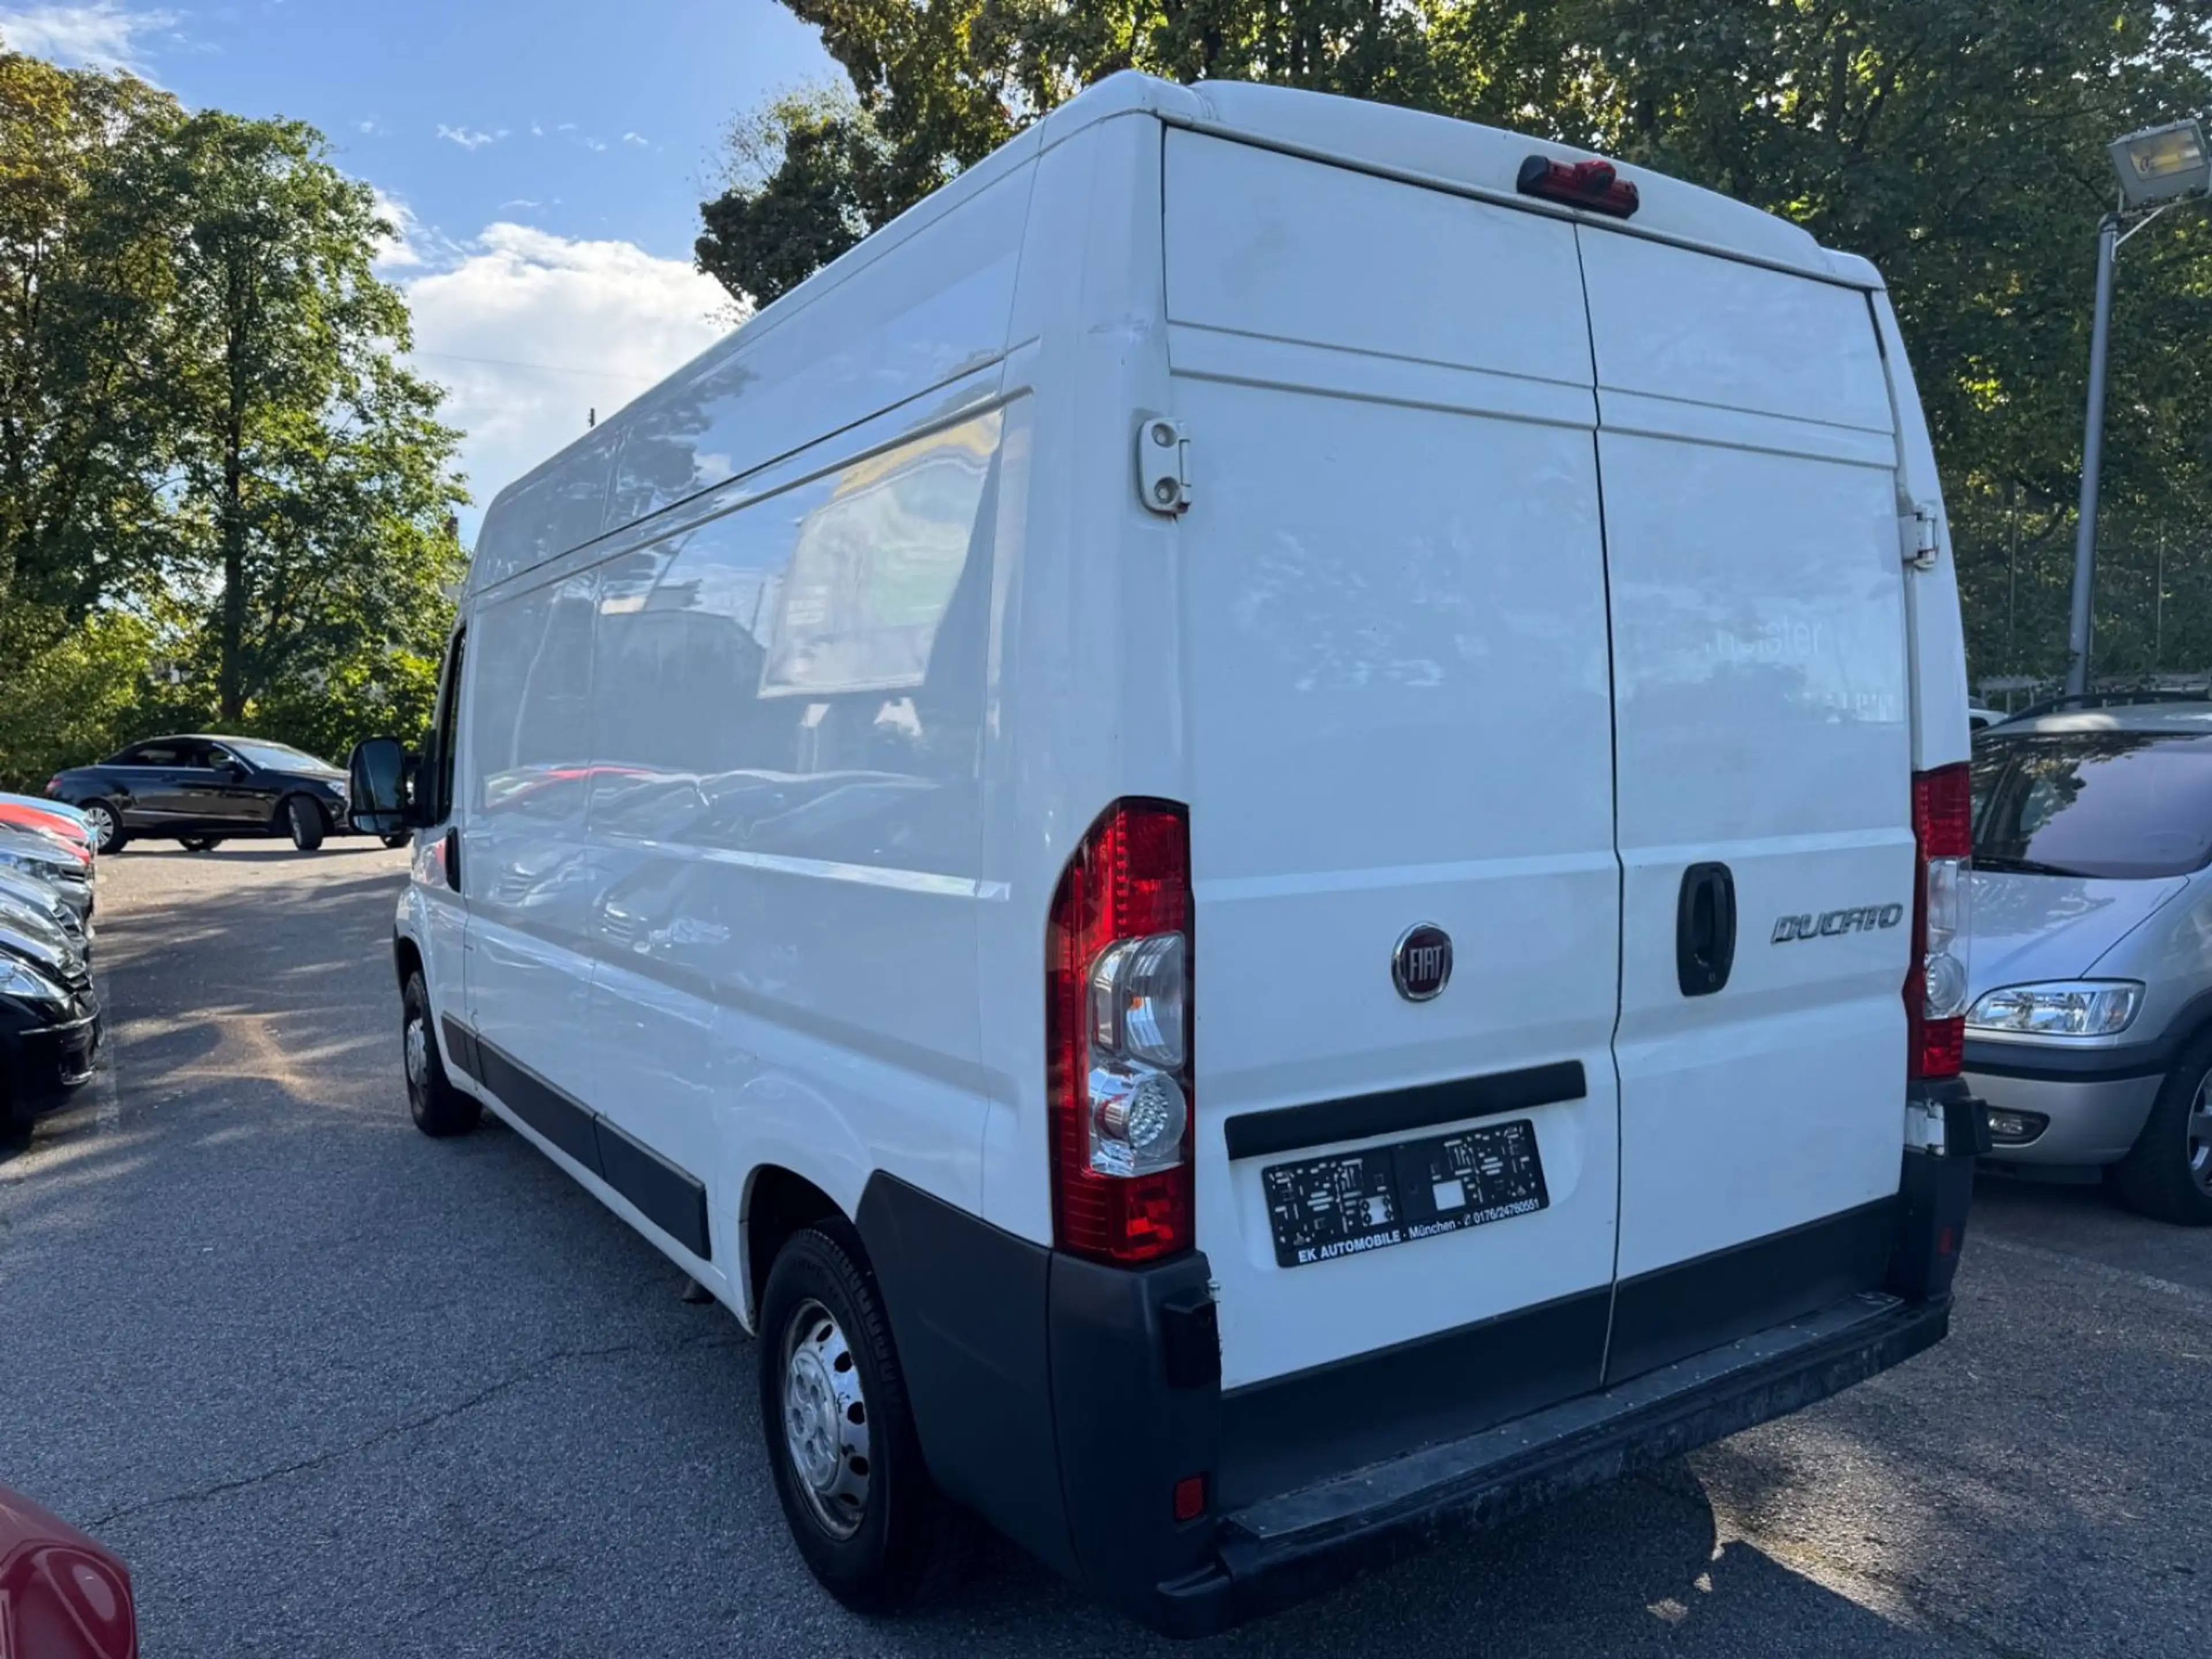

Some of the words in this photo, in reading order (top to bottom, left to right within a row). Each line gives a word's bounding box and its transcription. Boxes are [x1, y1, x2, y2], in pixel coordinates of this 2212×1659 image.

[1770, 902, 1904, 945] DUCATO
[1409, 945, 1443, 982] FIAT
[1298, 1248, 1317, 1263] EK
[1320, 1229, 1402, 1259] AUTOMOBILE
[1408, 1219, 1456, 1238] München
